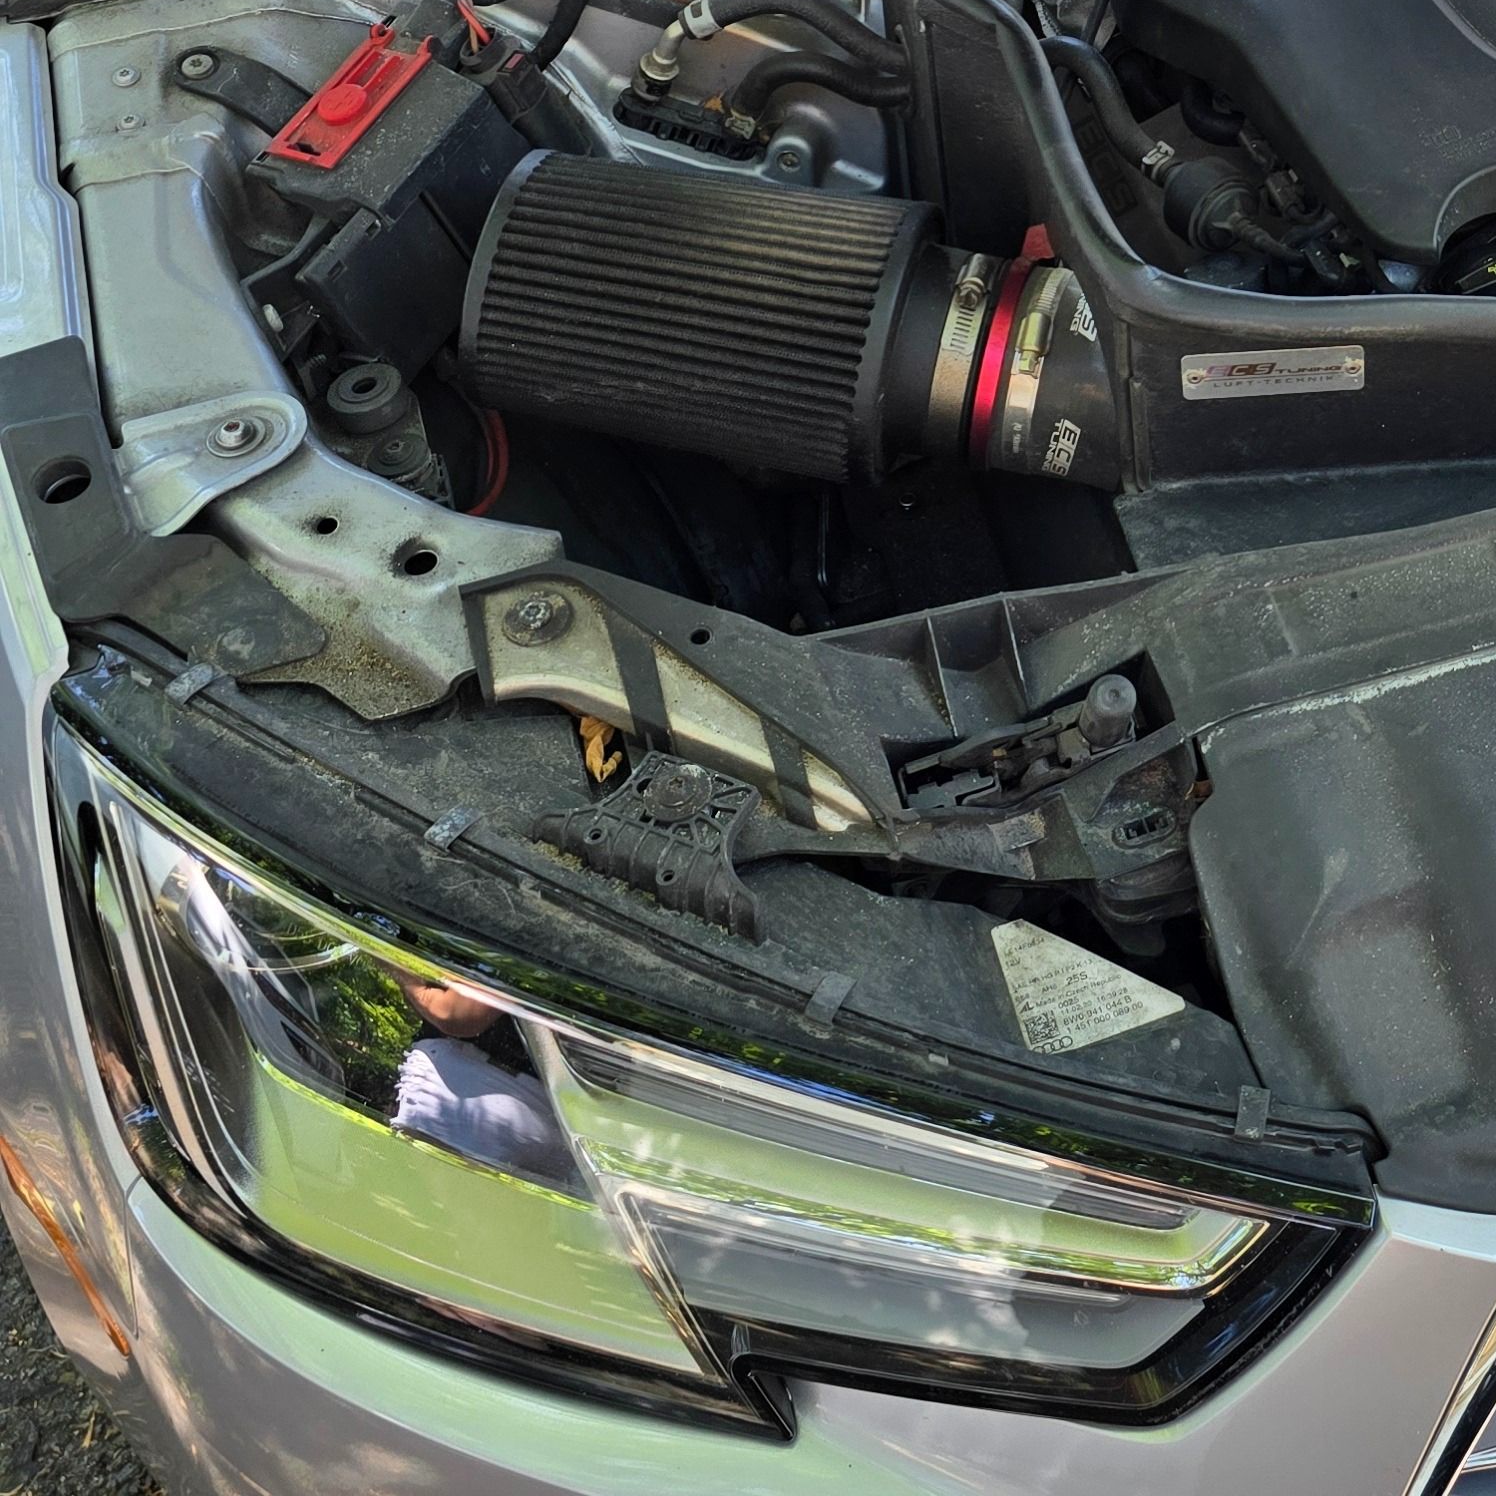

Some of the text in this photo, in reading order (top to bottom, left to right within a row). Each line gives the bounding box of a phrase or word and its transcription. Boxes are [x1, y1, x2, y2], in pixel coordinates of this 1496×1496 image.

[1206, 362, 1343, 376] ECS TUNING
[1050, 419, 1081, 477] ECS
[1065, 985, 1089, 997] Czech
[1090, 974, 1121, 988] Republic
[1066, 971, 1088, 985] 25S
[1058, 998, 1080, 1009] 0025
[1063, 995, 1132, 1026] 8W0 941 044 B
[1075, 1020, 1091, 1032] 451
[1094, 1012, 1111, 1025] 000
[1132, 1000, 1144, 1011] 00
